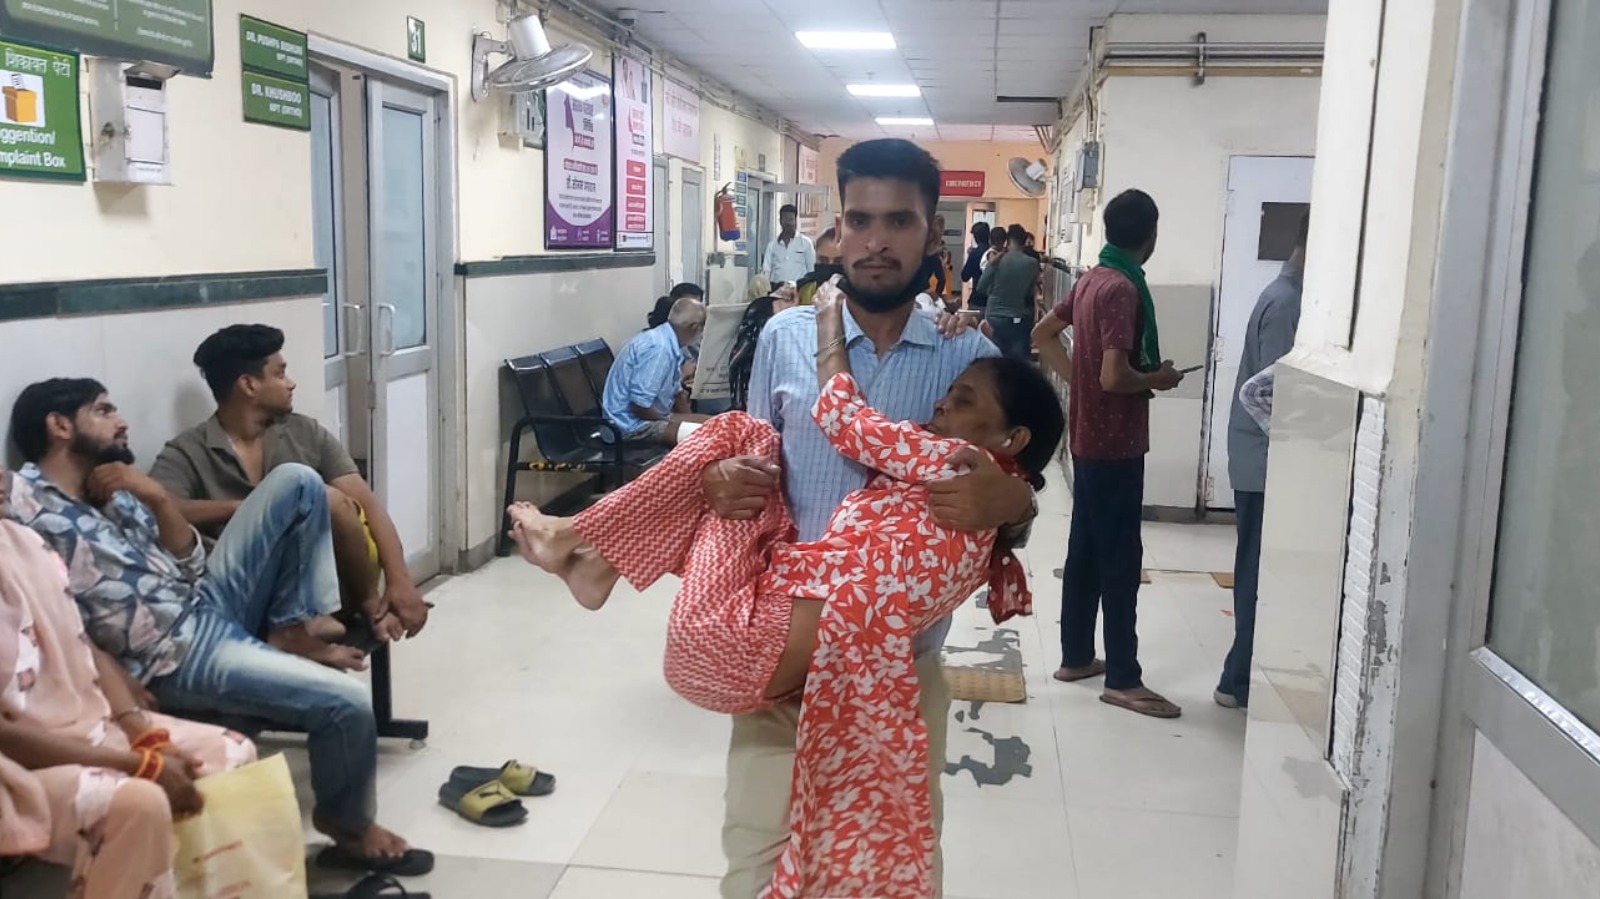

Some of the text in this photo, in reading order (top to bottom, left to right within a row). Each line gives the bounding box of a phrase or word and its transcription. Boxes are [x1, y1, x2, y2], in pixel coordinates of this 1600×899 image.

[411, 28, 422, 54] 31
[5, 47, 71, 78] शिकायत पेटी
[251, 82, 302, 105] DR. KHUSHBOO
[0, 127, 56, 146] ggention/
[43, 151, 67, 168] Box
[945, 180, 982, 188] EMERGENCY
